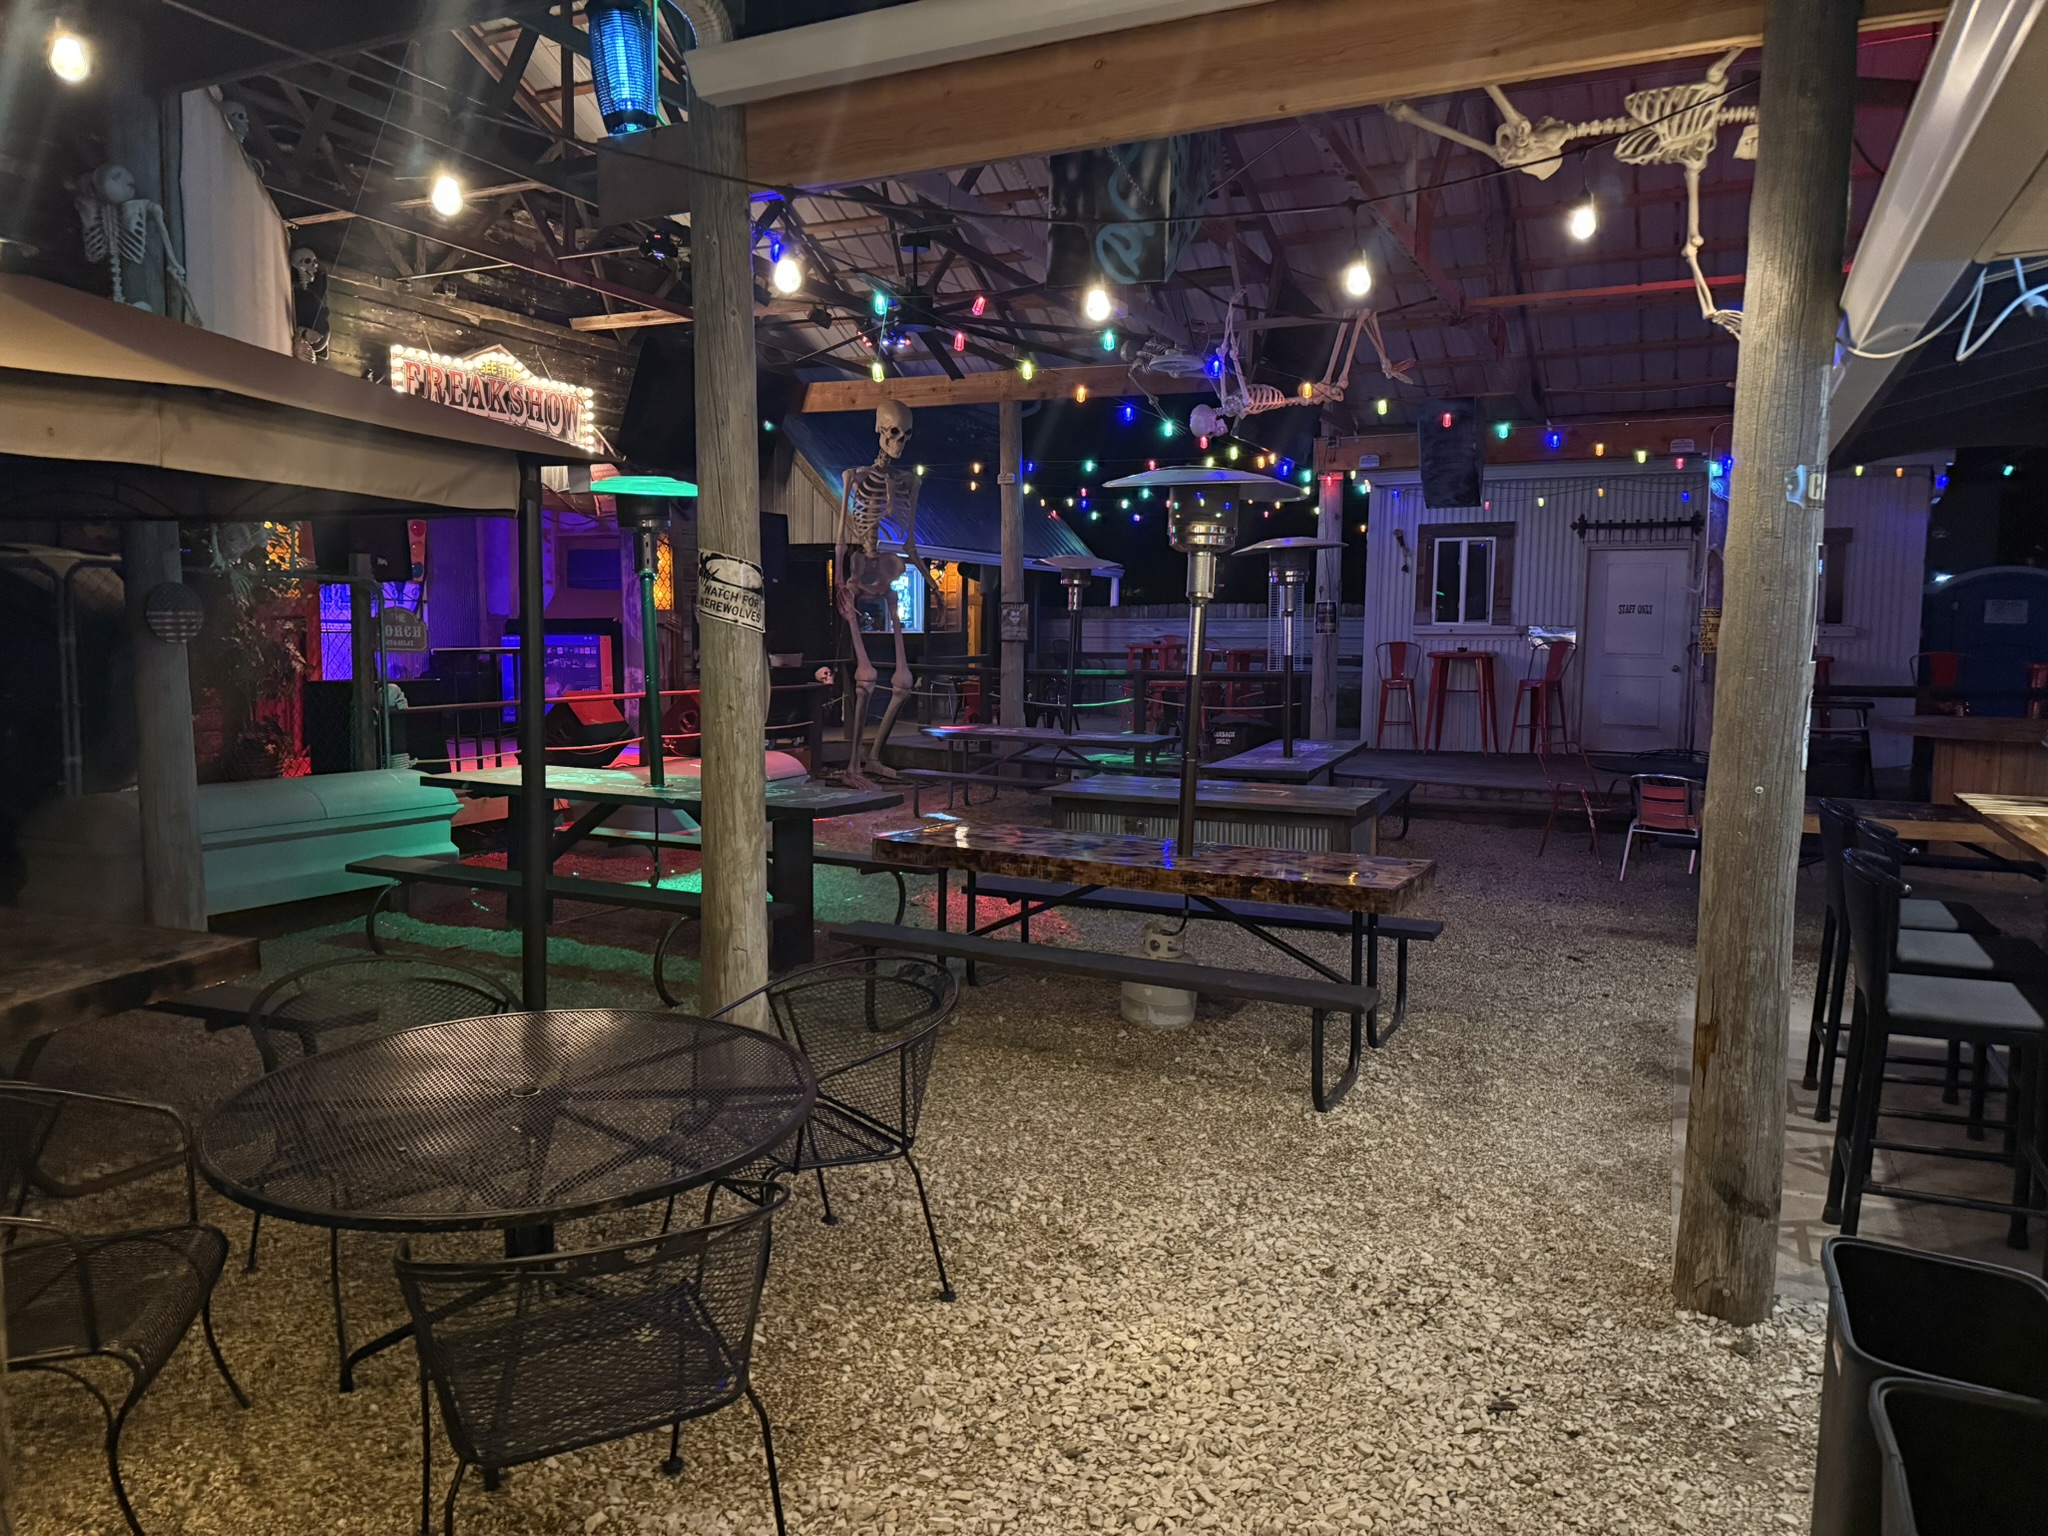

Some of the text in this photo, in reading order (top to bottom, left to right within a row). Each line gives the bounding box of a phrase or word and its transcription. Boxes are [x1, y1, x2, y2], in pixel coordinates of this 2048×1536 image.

[481, 361, 498, 375] SEE
[403, 361, 583, 440] FREAKSHOW
[704, 586, 739, 602] WATCH
[1618, 604, 1653, 614] STAFF ONLY
[383, 624, 421, 637] ORCH
